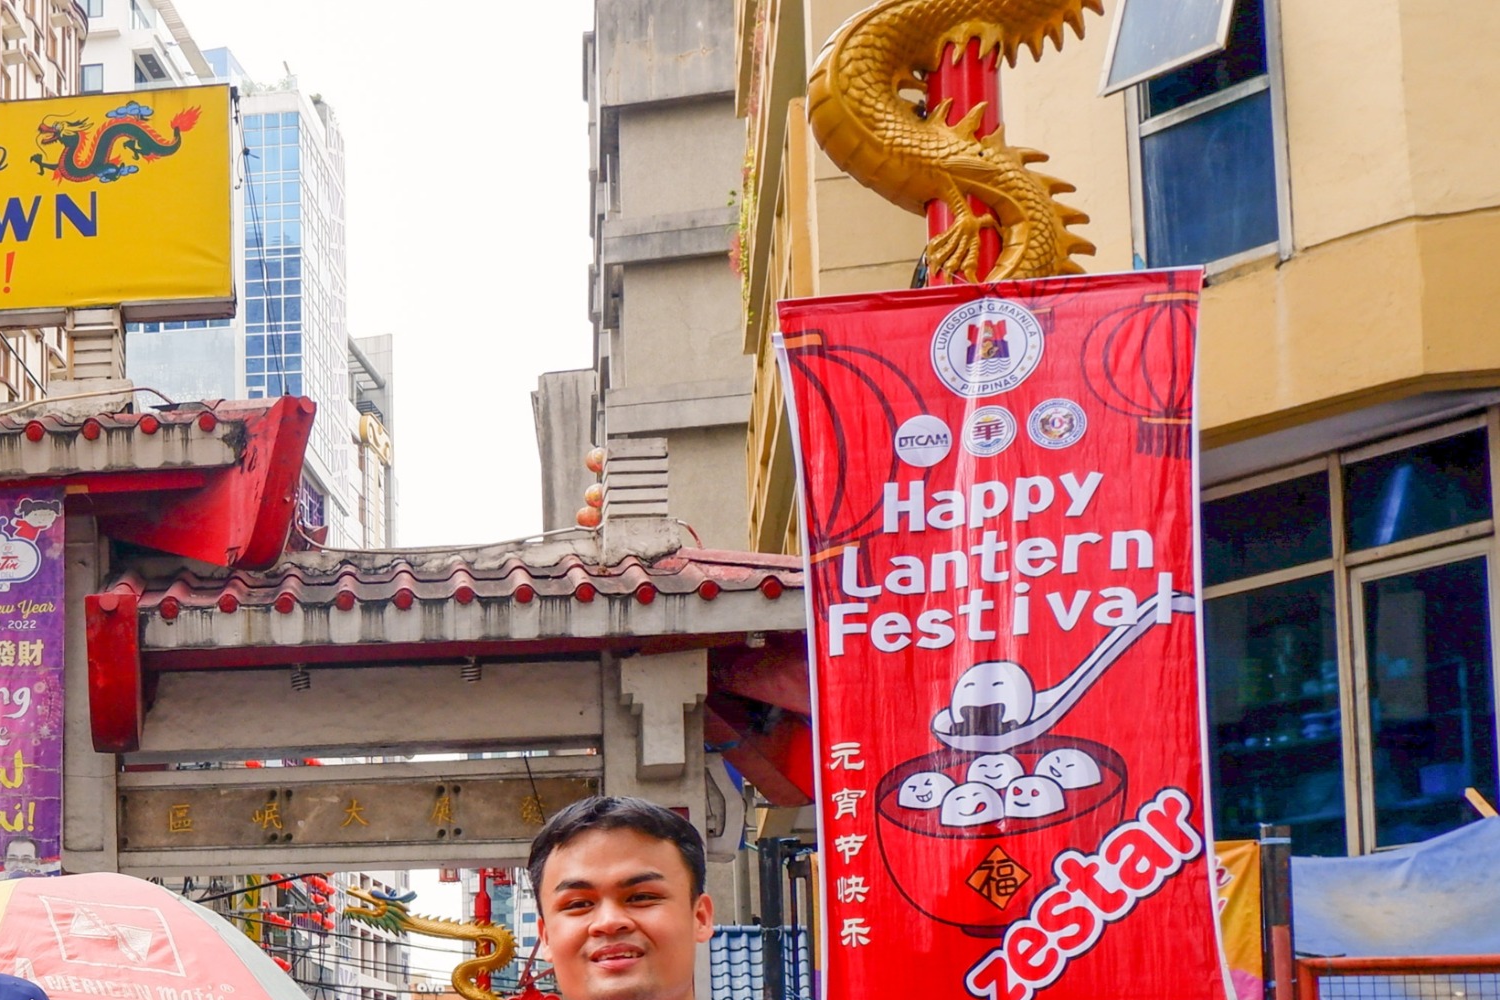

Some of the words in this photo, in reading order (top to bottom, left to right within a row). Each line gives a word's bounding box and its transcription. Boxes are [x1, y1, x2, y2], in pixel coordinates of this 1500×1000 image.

[937, 307, 976, 350] LUNGSOD
[998, 303, 1037, 338] MAYNILA
[959, 374, 1018, 393] PILIPINAS
[898, 433, 949, 448] DTCAM
[883, 471, 1104, 533] Happy
[842, 528, 1154, 598] Lantern
[7, 620, 36, 630] 2022
[17, 600, 56, 619] Year
[828, 571, 1174, 657] Festival
[829, 741, 872, 948] 元宵节快乐
[982, 859, 1018, 901] 福
